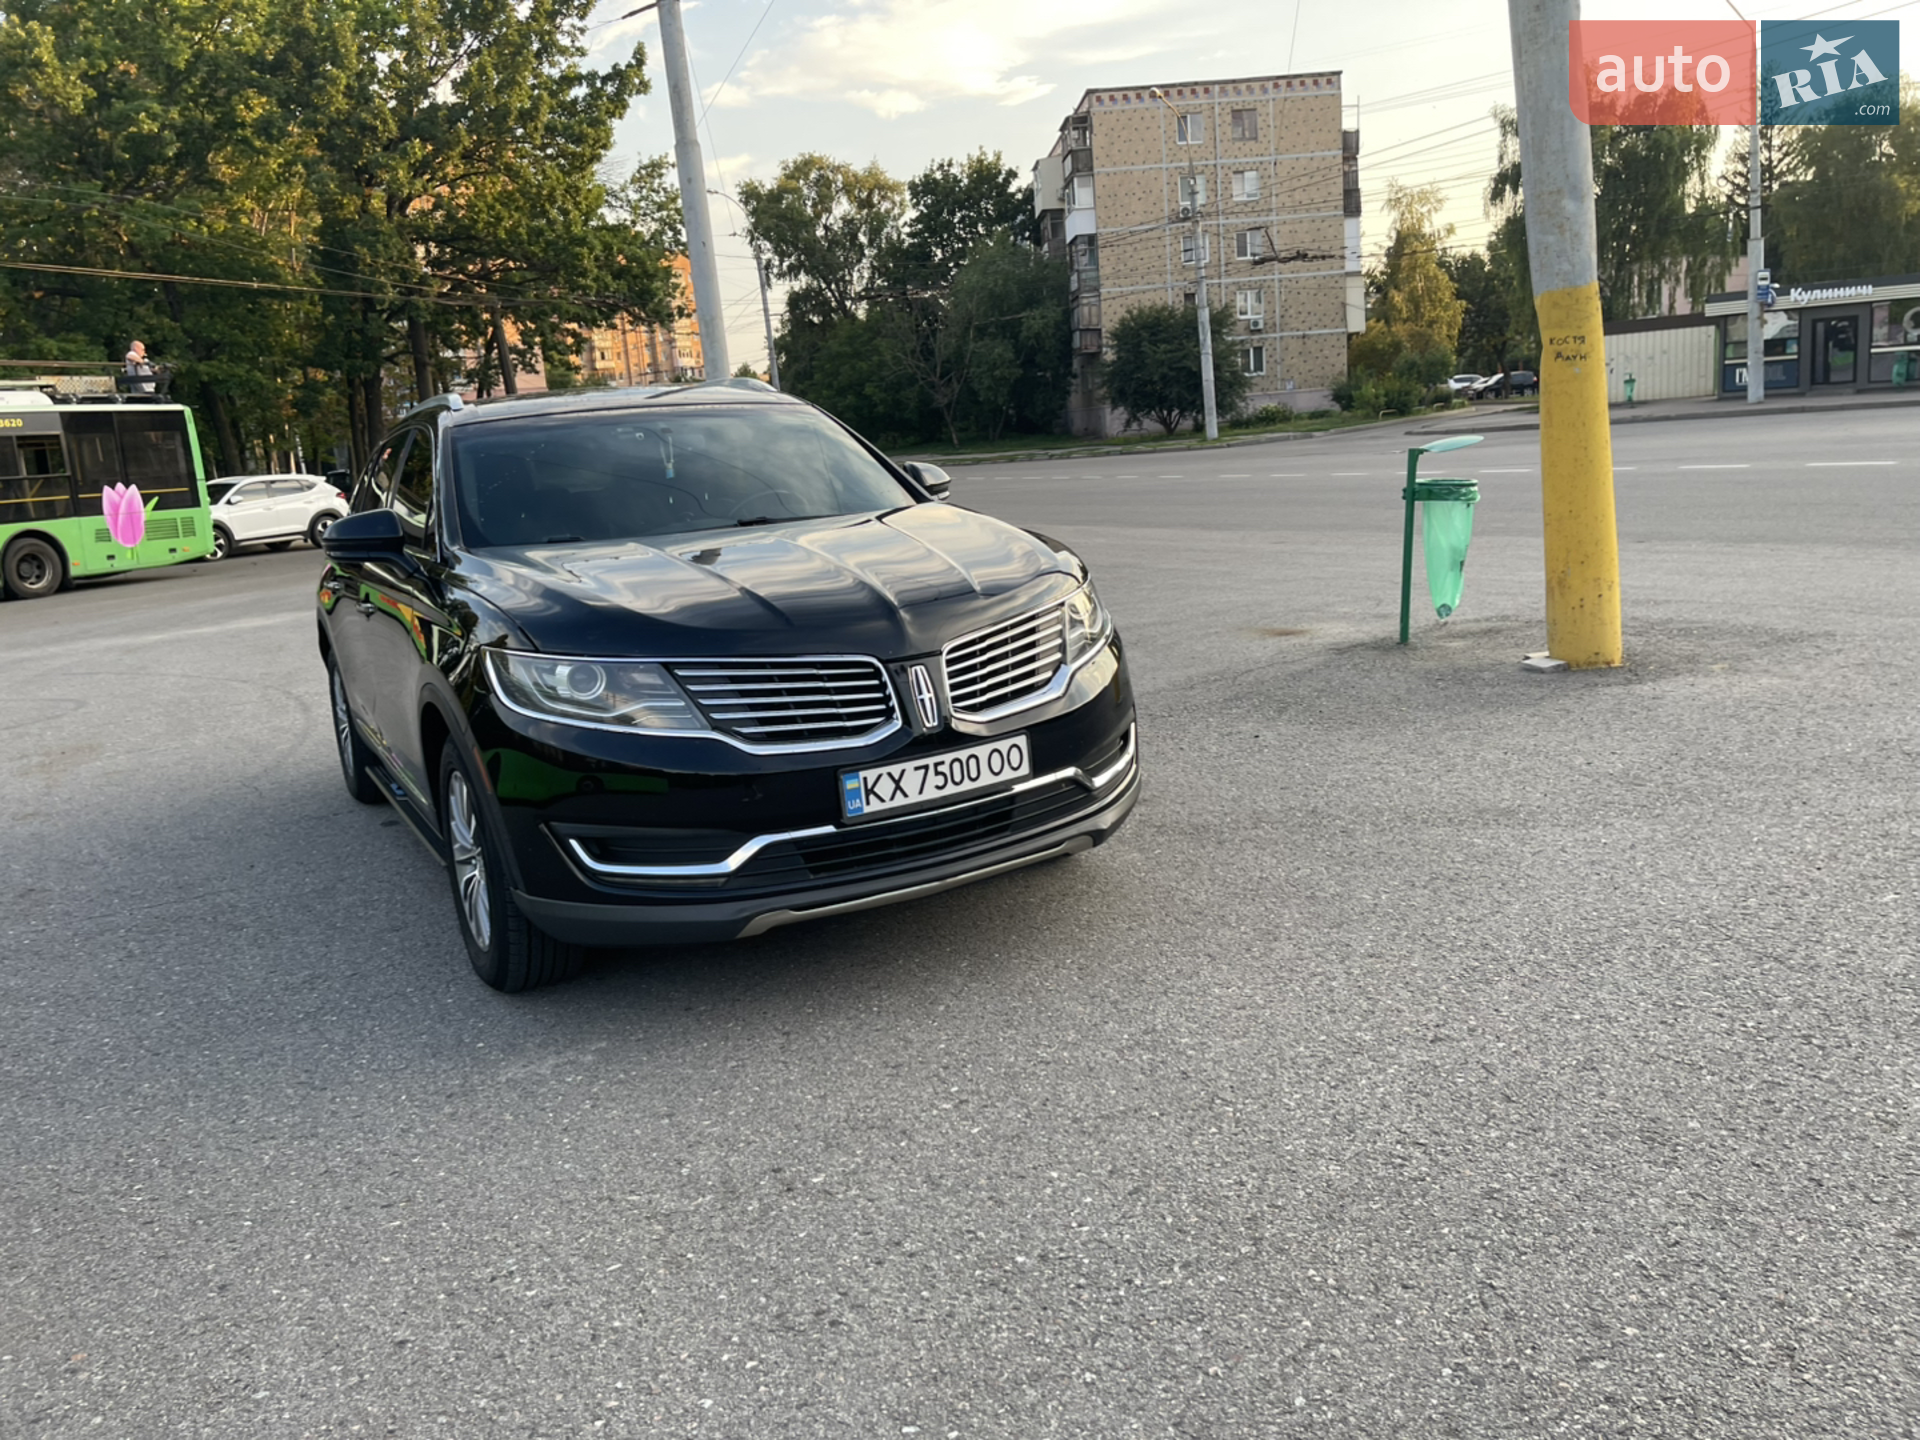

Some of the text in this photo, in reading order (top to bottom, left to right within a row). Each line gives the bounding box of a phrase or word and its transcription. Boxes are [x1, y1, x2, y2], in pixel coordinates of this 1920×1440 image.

[1790, 284, 1873, 305] Кулиничі
[862, 768, 909, 806] KX
[913, 752, 982, 796] 7500
[847, 798, 862, 811] UA
